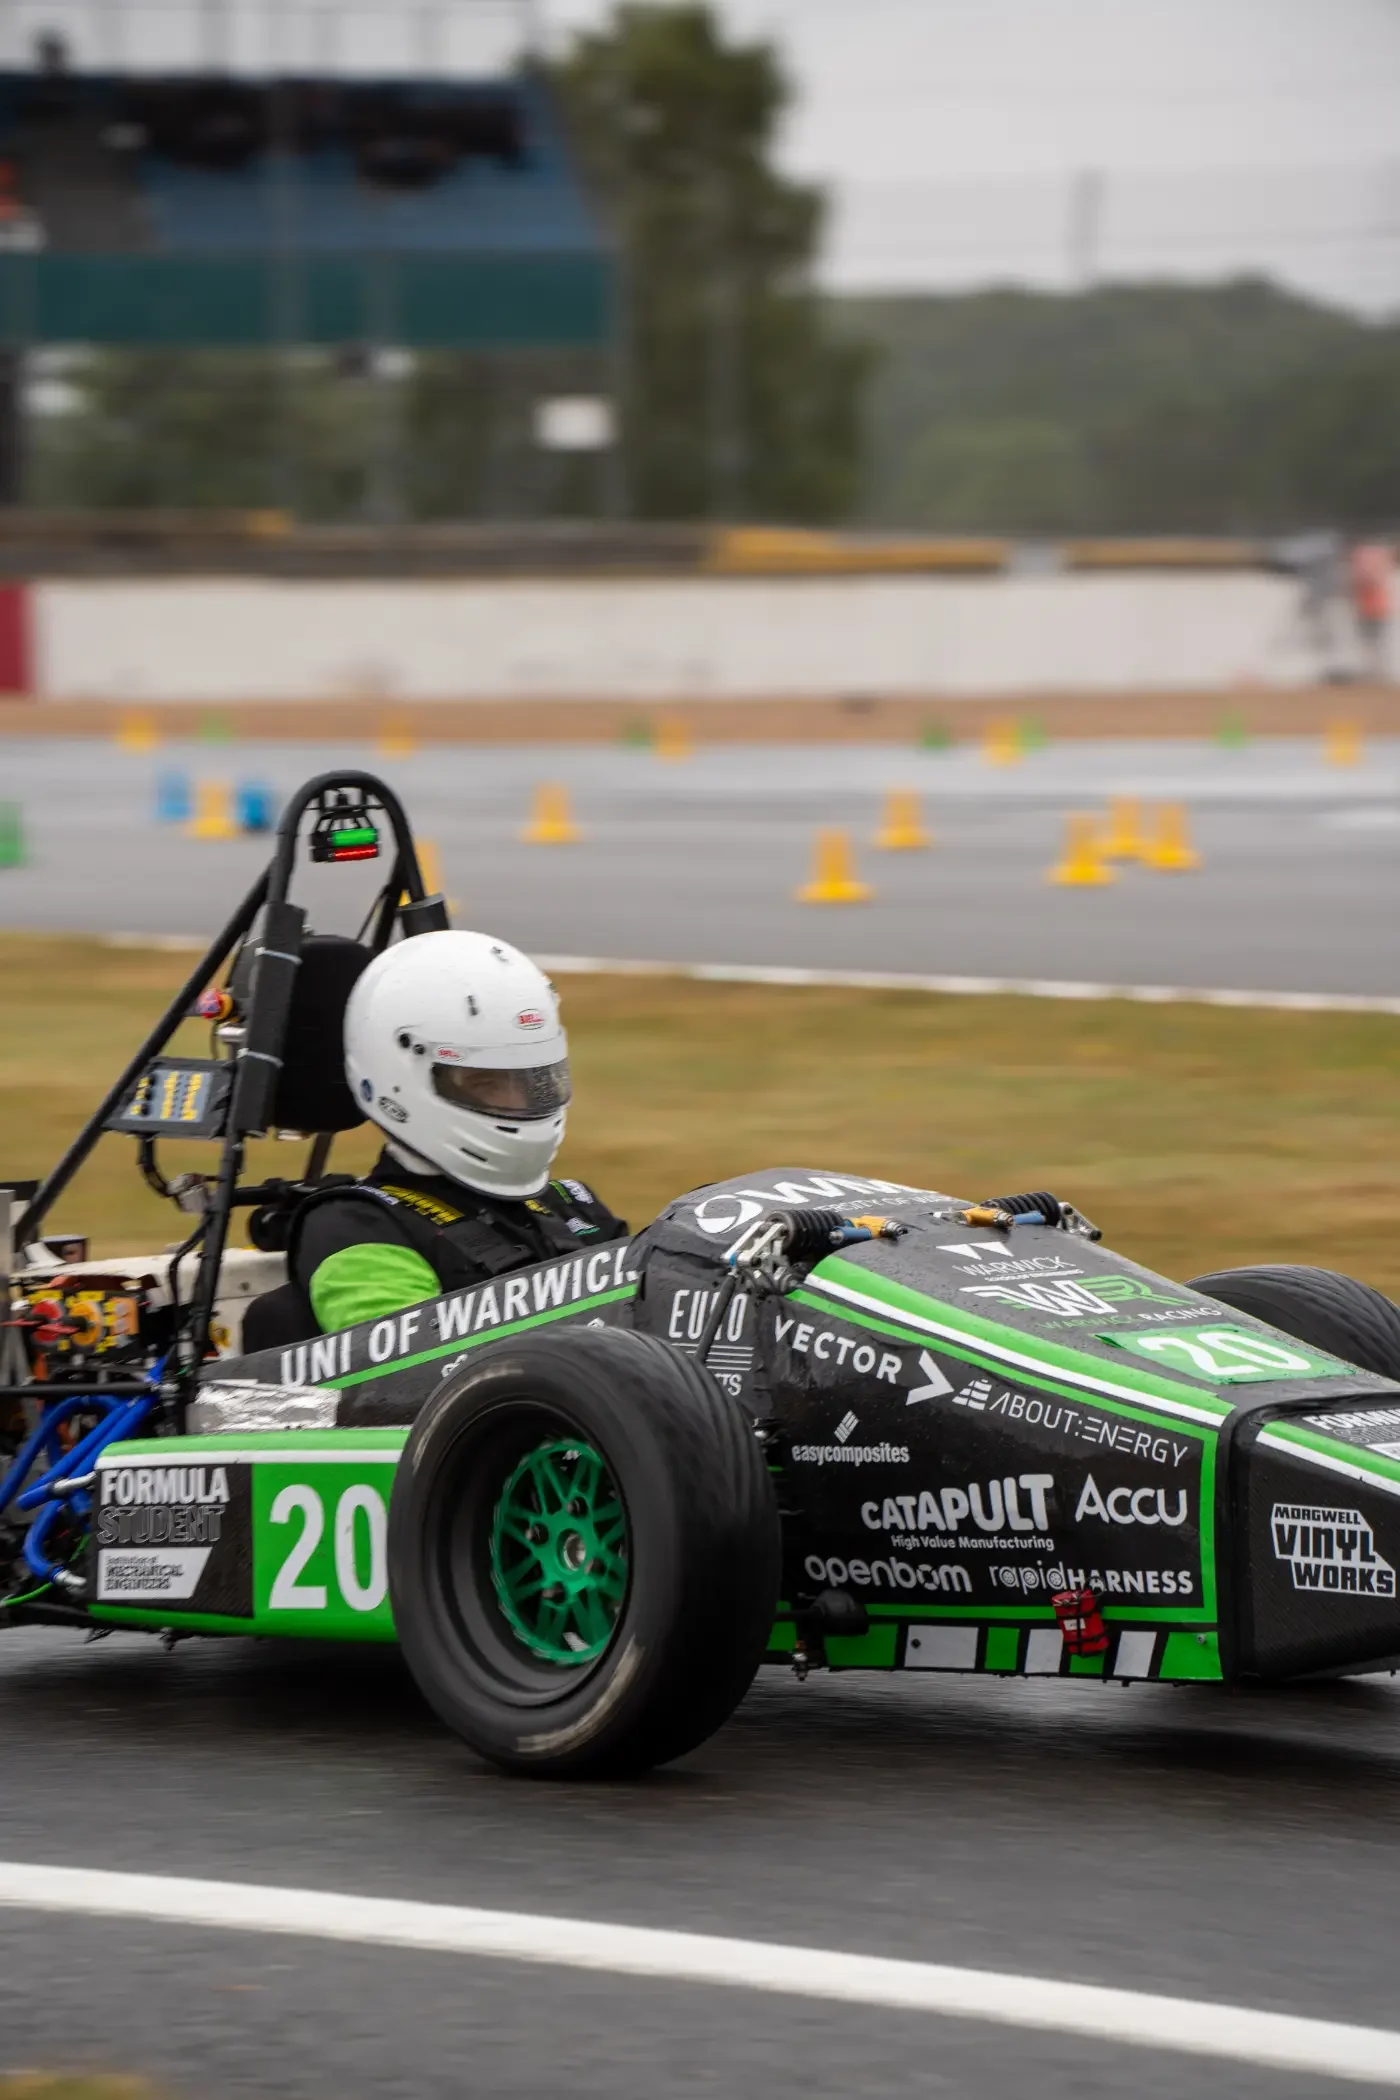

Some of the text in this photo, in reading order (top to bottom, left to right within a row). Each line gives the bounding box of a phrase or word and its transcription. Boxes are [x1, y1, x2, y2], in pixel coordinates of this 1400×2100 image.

[951, 1256, 1077, 1276] WARWICK
[1137, 1307, 1222, 1322] RACING
[281, 1331, 353, 1388] UNI
[368, 1309, 423, 1363] OF
[774, 1314, 903, 1384] VECTOR
[1136, 1331, 1312, 1376] 20
[791, 1442, 910, 1467] easycomposites
[101, 1467, 231, 1505] FORMULA
[861, 1474, 1055, 1531] CATAPULT
[96, 1504, 226, 1544] STUDENT
[1273, 1505, 1361, 1525] MORGWELL
[268, 1484, 389, 1612] 20
[891, 1535, 1055, 1551] High Value Manufacturing
[804, 1554, 973, 1593] openbom
[1293, 1562, 1394, 1594] WORKS
